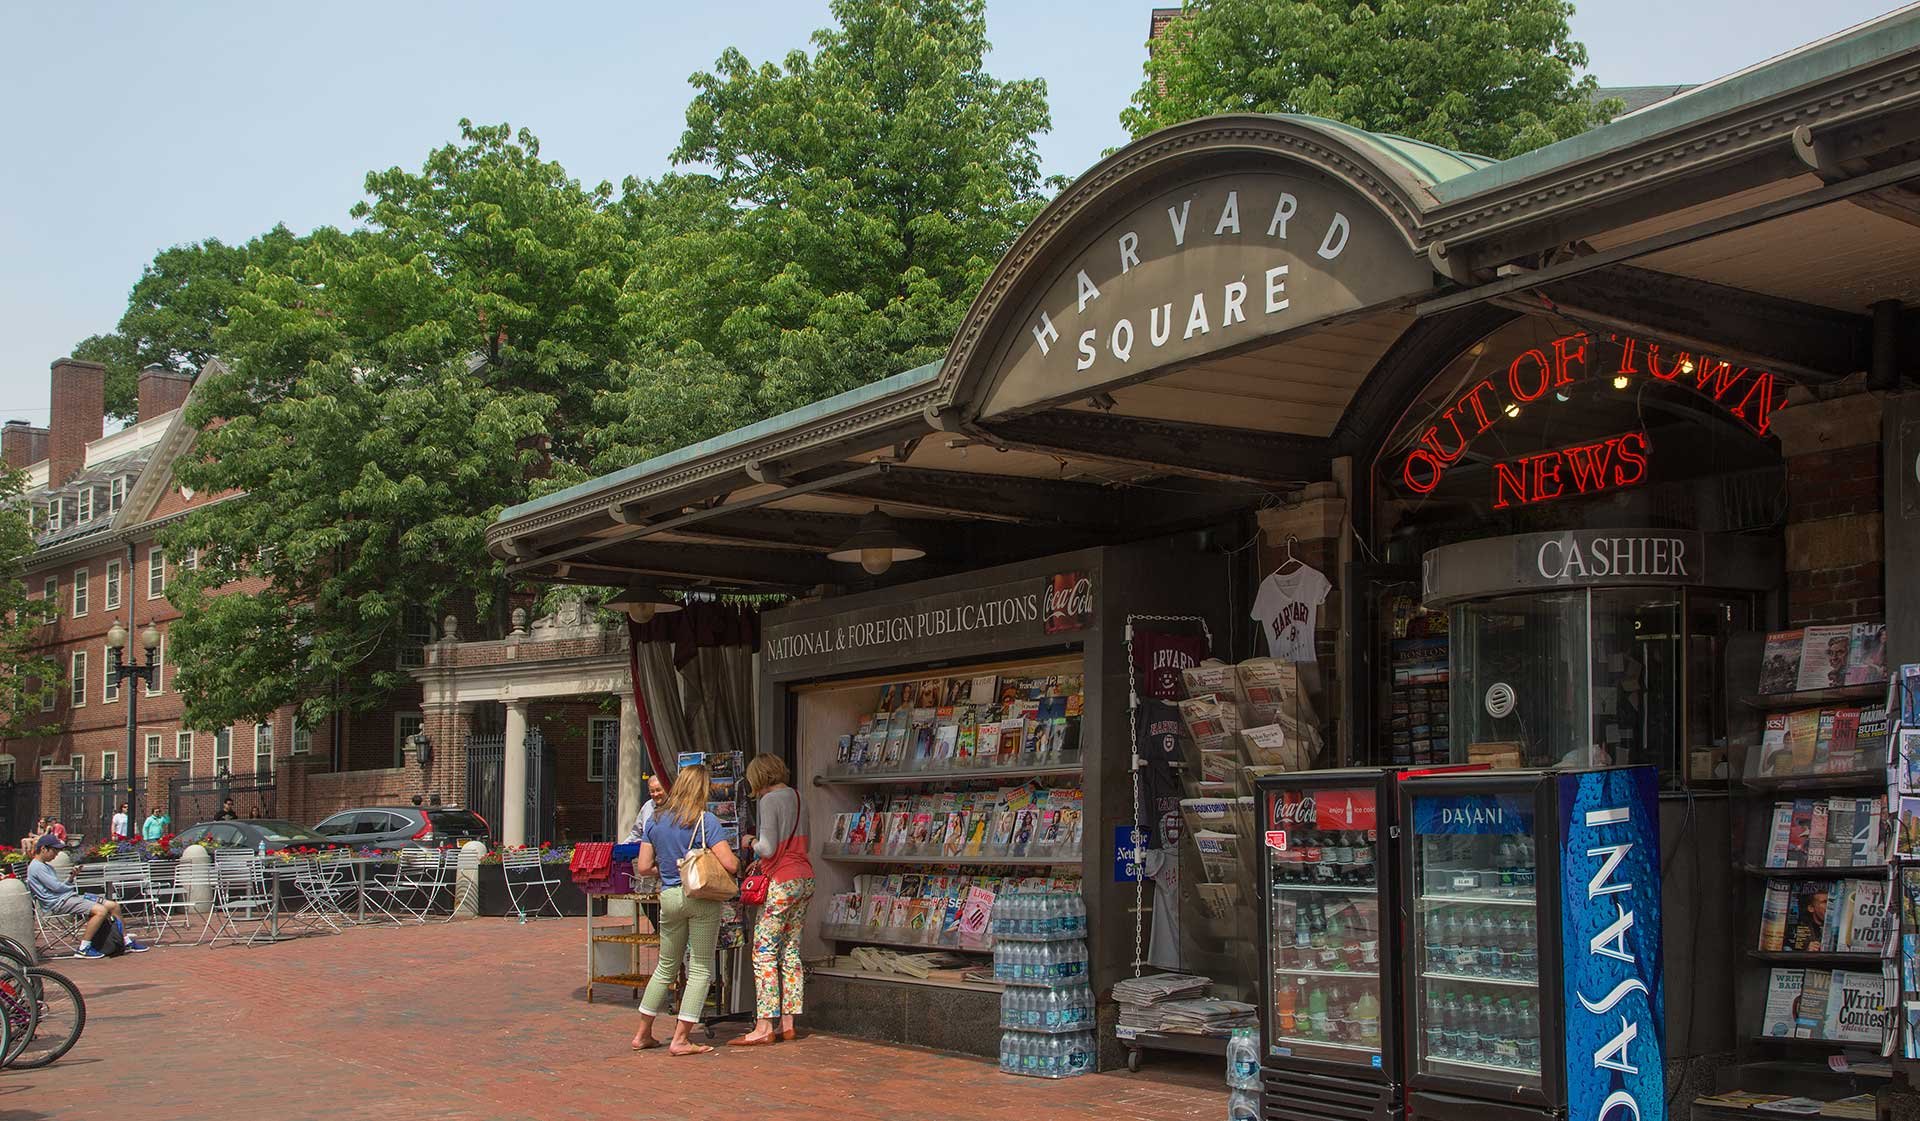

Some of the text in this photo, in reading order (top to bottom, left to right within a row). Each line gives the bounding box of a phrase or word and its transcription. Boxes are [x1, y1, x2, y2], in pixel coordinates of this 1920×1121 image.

[1031, 191, 1350, 357] HARVARD
[1077, 265, 1290, 372] SQUARE
[1403, 380, 1495, 493] OUT
[1508, 332, 1590, 402] OF
[1493, 433, 1647, 508] NEWS
[1537, 537, 1688, 579] CASHIER
[1042, 578, 1094, 623] Coca-Cola
[767, 594, 1038, 662] NATIONAL & FOREIGN PUBLICATIONS
[1329, 807, 1344, 815] enjoy
[1442, 803, 1503, 828] DASANI
[1859, 903, 1884, 916] COS
[1776, 974, 1801, 982] WRIT
[1842, 988, 1885, 1012] Writi
